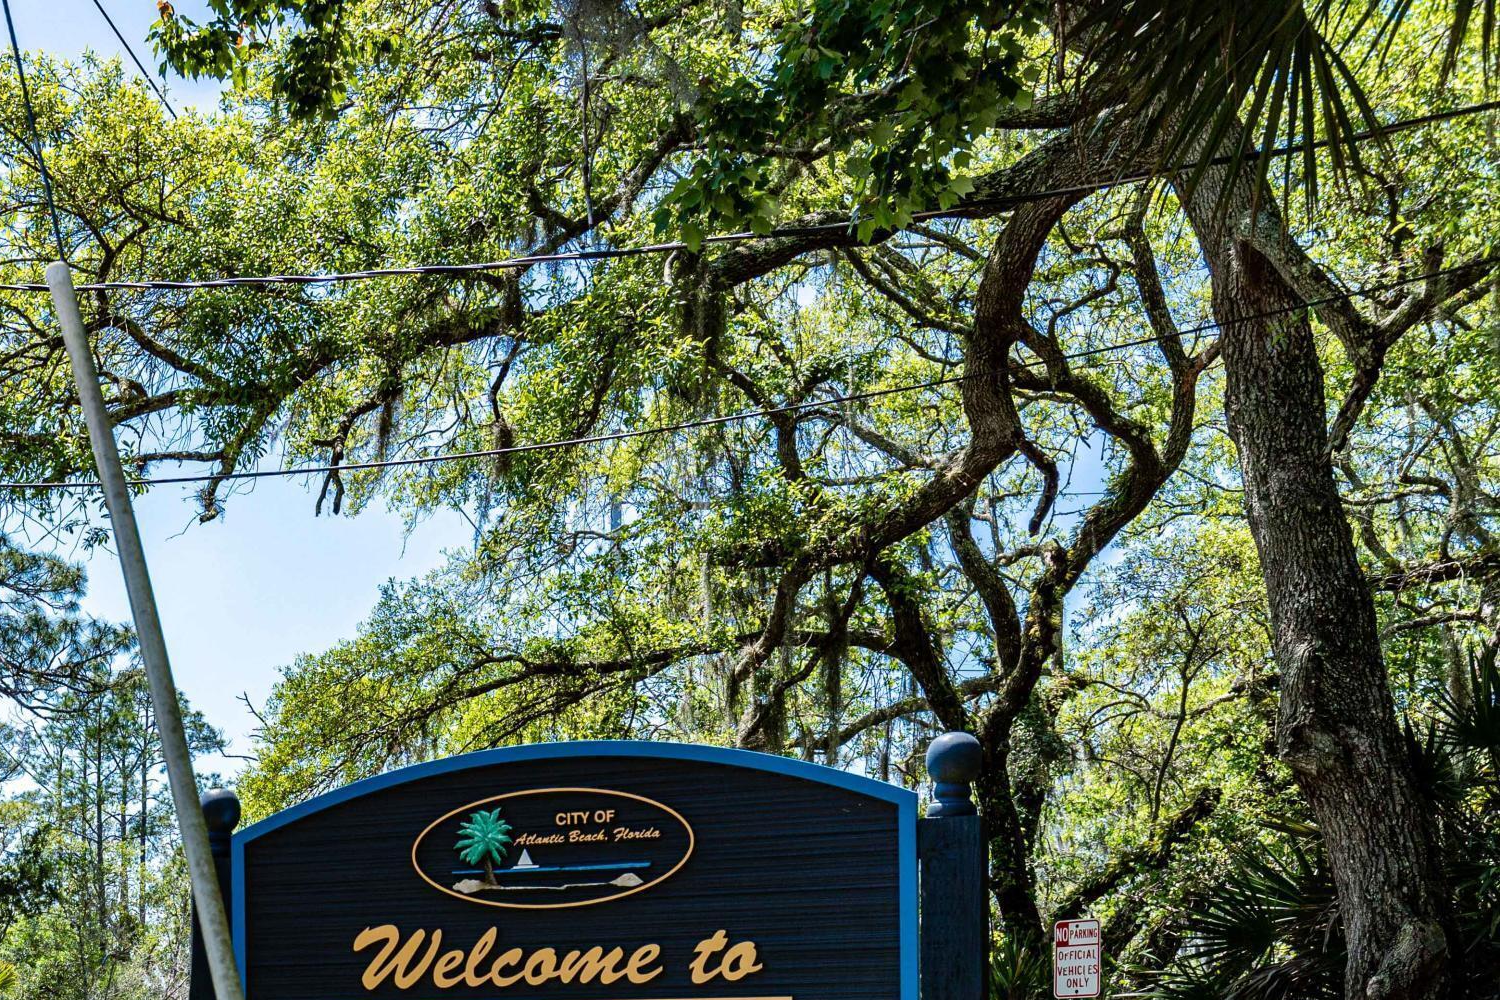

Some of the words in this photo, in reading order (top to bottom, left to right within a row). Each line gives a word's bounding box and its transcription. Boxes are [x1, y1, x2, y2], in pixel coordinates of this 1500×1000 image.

[556, 812, 590, 826] CITY
[594, 810, 615, 822] OF
[514, 832, 564, 846] Atlantic
[613, 827, 660, 841] Florida
[1057, 928, 1068, 942] NO
[1070, 928, 1097, 939] PARKING
[352, 924, 663, 990] Welcome
[689, 929, 763, 983] to
[1059, 950, 1096, 960] OFFICIAL
[1058, 965, 1098, 976] VEHICLES
[1067, 978, 1089, 988] ONLY
